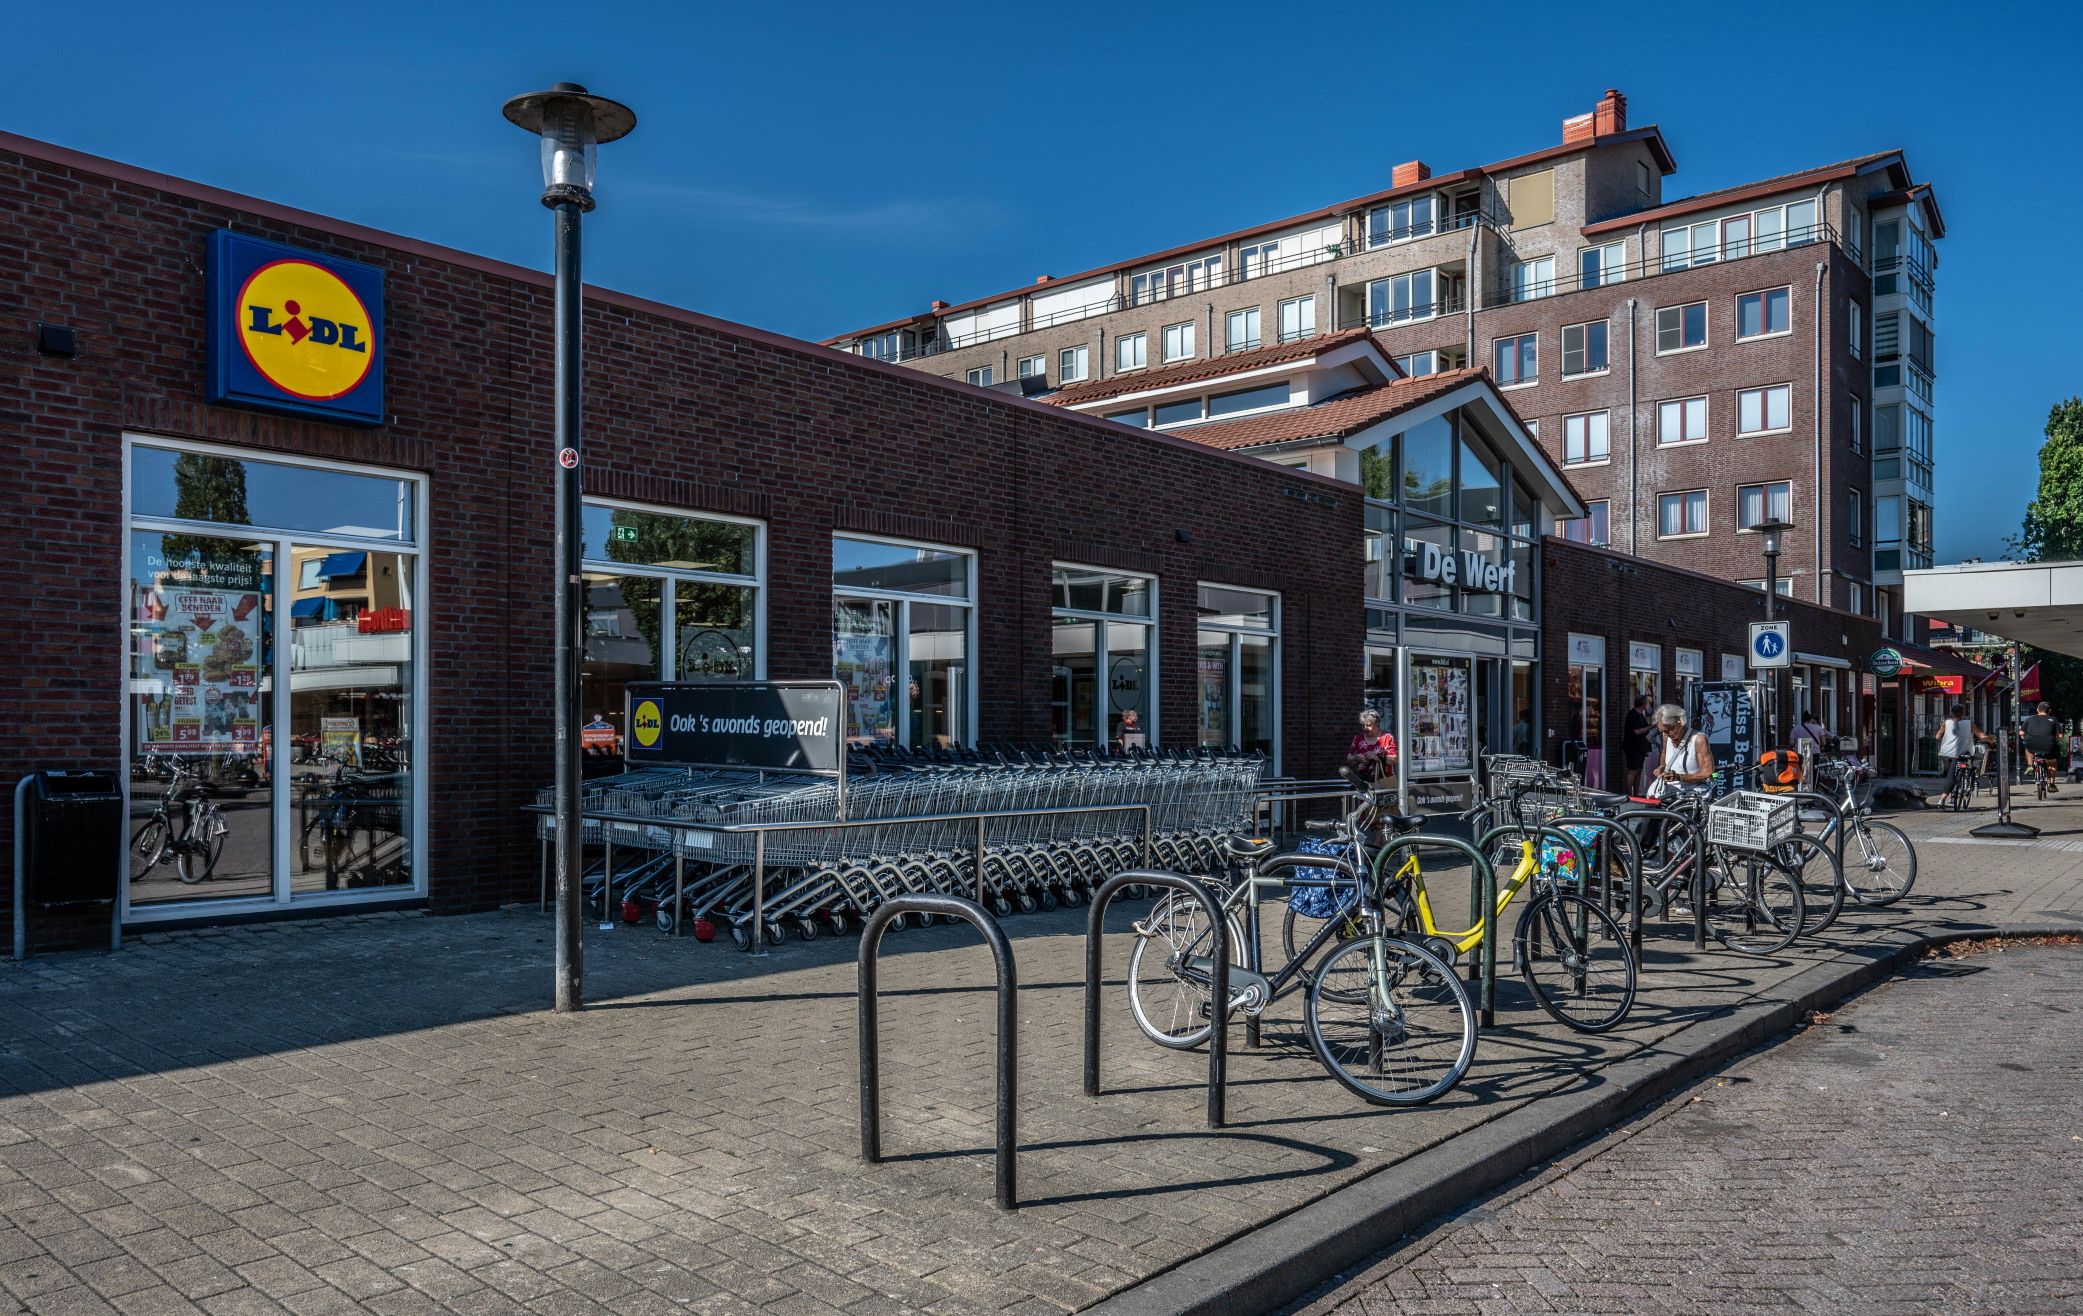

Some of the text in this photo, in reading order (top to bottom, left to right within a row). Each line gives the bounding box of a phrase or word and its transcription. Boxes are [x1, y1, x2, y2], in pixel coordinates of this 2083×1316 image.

[147, 556, 253, 573] De hoogste kwaliteit
[1422, 543, 1515, 593] De Werf
[147, 570, 171, 579] voor
[190, 571, 225, 584] laagste
[227, 575, 253, 586] prijs!
[1922, 679, 1954, 687] Wibra
[1735, 690, 1751, 735] Miss
[670, 715, 696, 732] Ook
[699, 714, 709, 733] 's
[712, 715, 760, 735] avonds
[763, 717, 828, 738] geopend!
